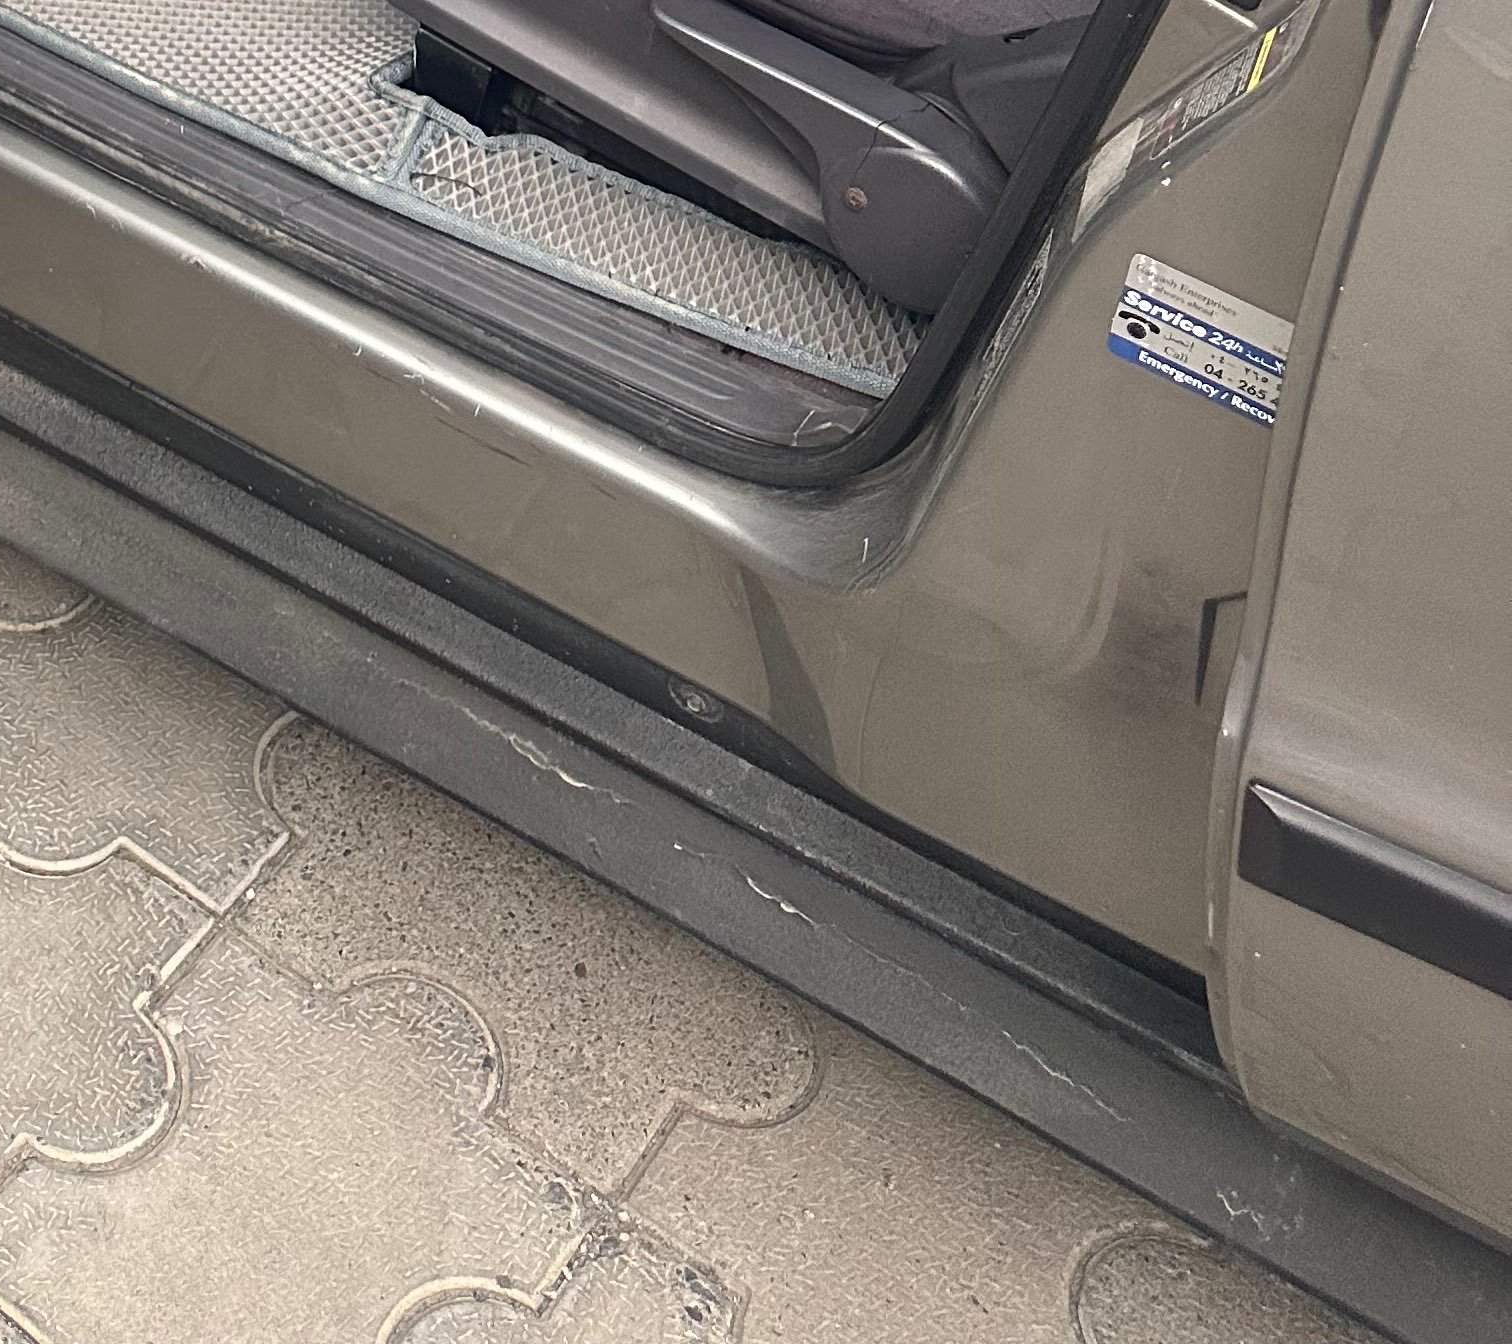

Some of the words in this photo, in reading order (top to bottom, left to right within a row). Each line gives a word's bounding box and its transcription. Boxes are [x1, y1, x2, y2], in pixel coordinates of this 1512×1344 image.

[1123, 289, 1207, 338] Service
[1207, 331, 1244, 353] 24h
[1138, 349, 1220, 399] Emergency
[1164, 345, 1188, 363] Call
[1204, 363, 1224, 380] 04
[1237, 378, 1267, 400] 265
